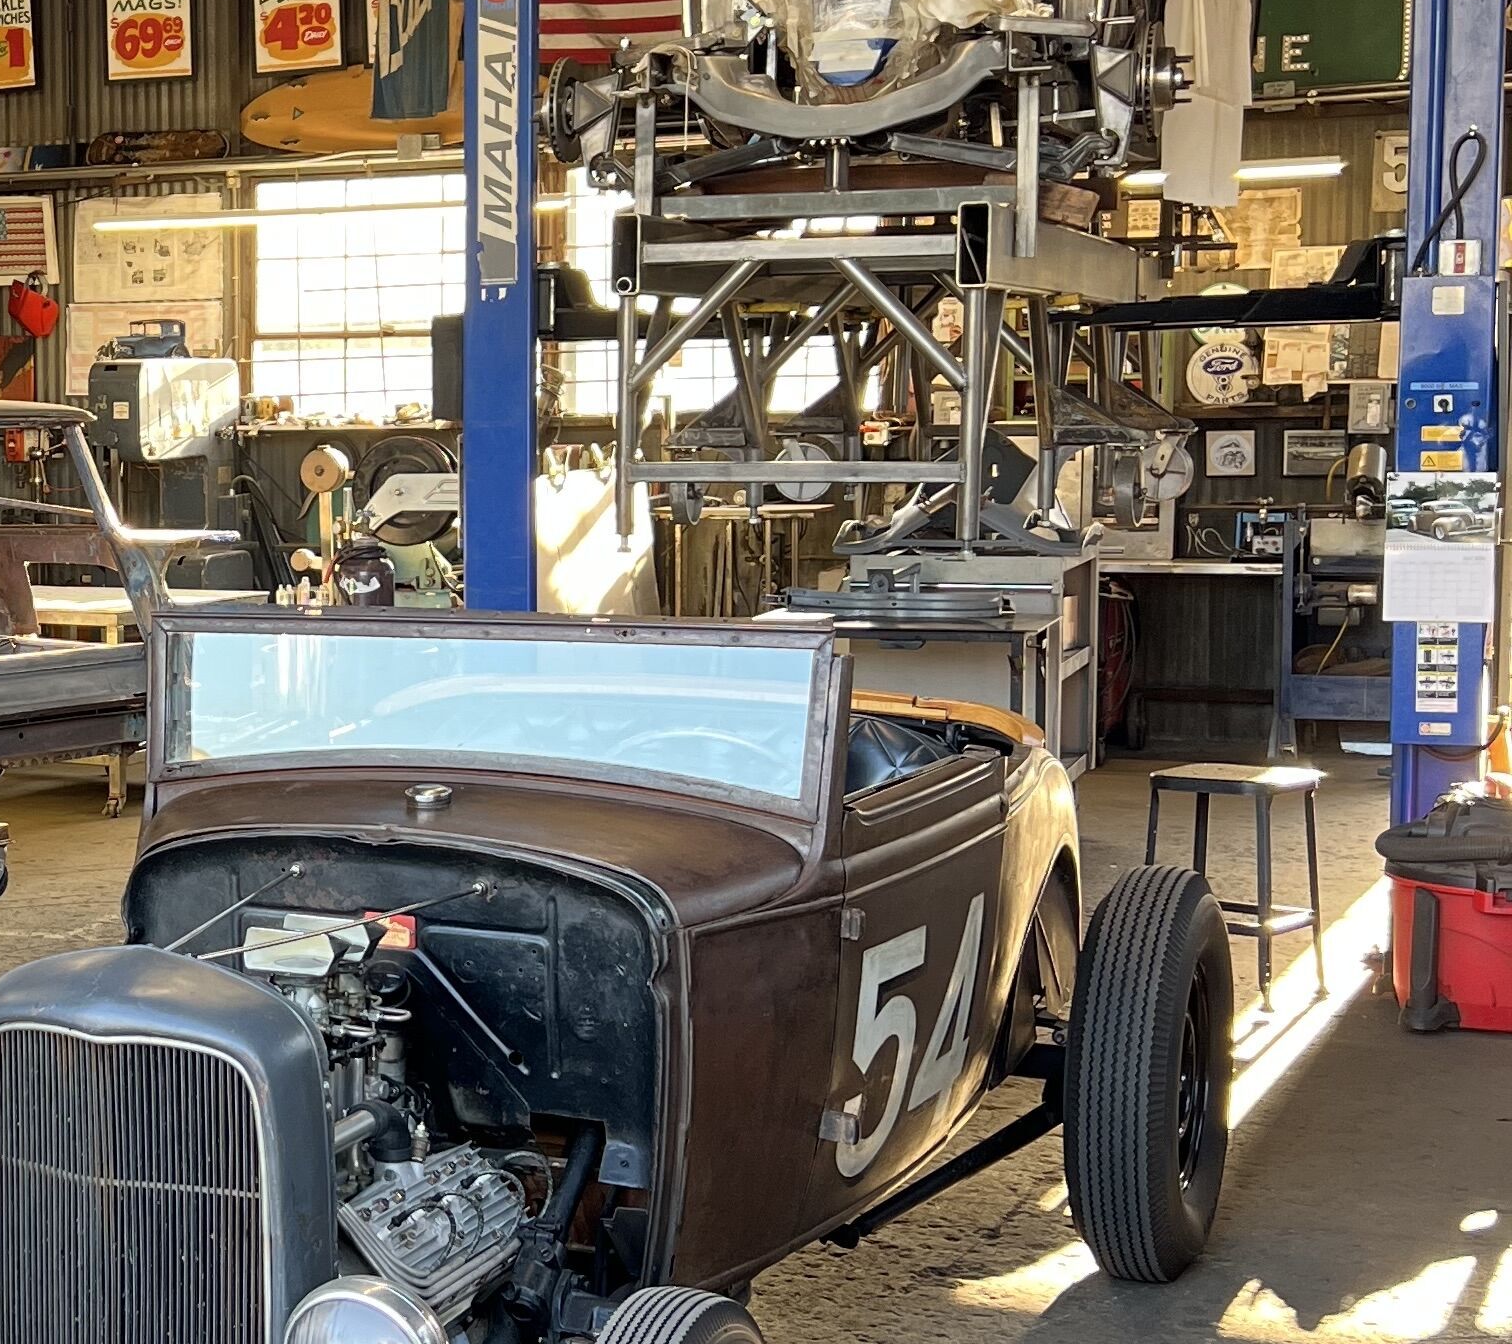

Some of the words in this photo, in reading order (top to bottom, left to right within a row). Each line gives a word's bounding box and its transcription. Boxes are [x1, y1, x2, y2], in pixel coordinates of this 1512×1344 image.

[5, 27, 26, 68] 1
[483, 49, 514, 232] MAHA
[1199, 345, 1248, 363] GENUINE
[1206, 358, 1239, 372] Ford
[1206, 392, 1245, 404] PARTS
[836, 892, 985, 1178] 54
